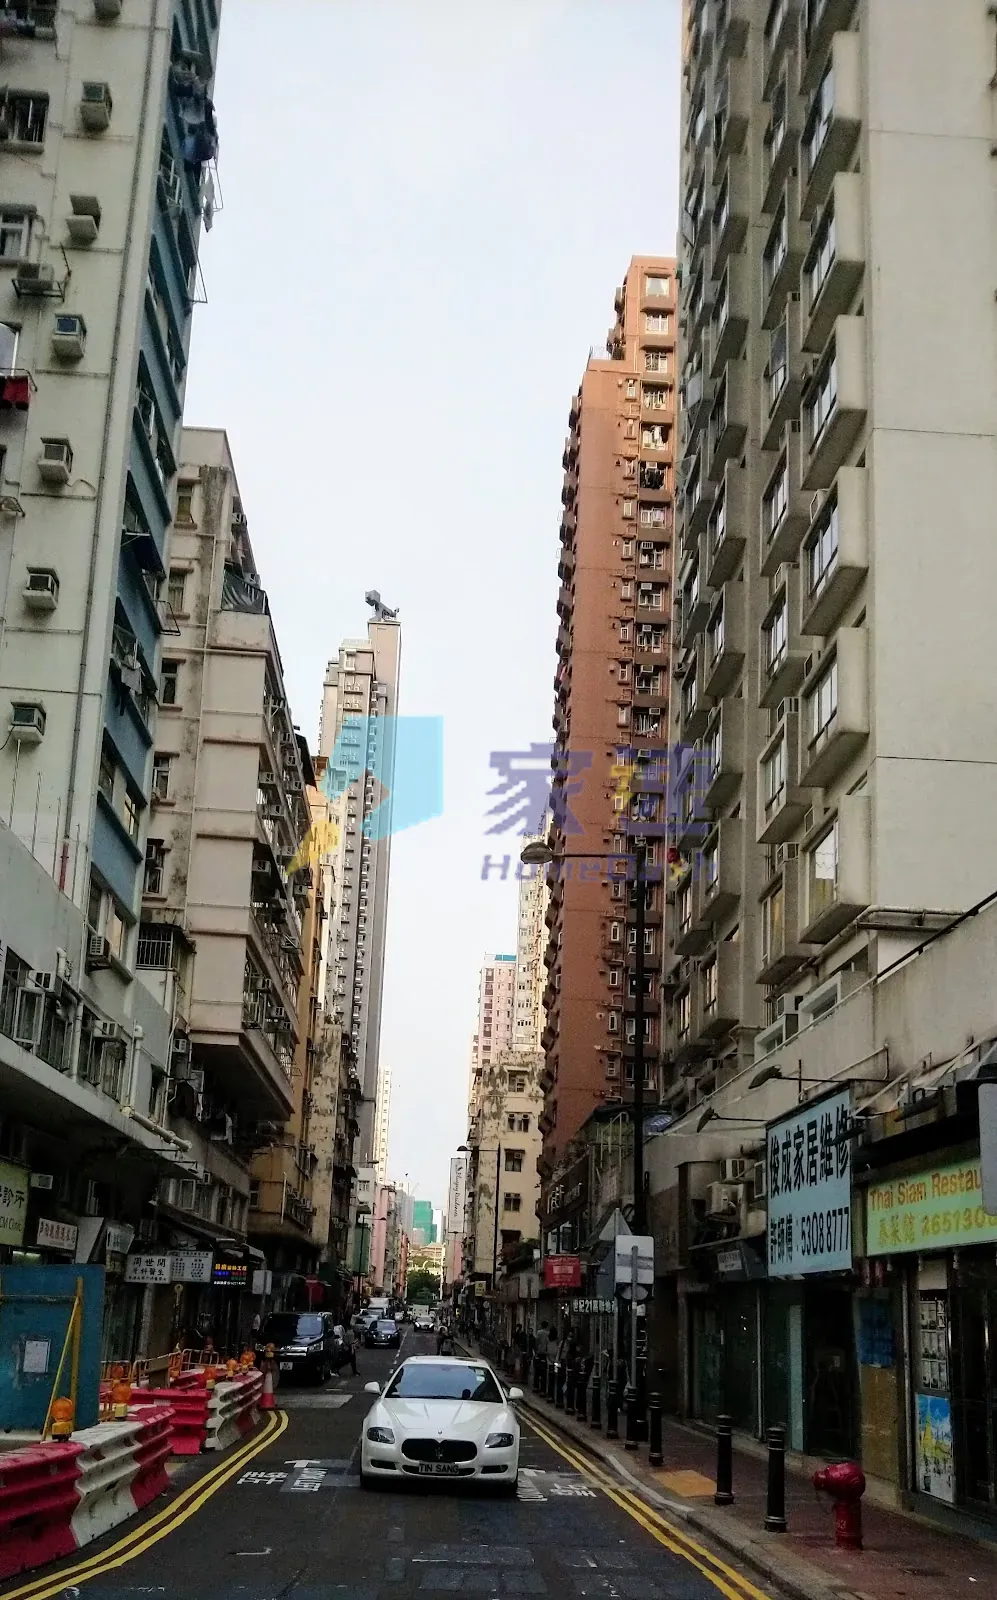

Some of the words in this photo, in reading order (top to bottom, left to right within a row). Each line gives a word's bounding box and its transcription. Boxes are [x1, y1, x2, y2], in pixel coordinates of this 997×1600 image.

[769, 1103, 851, 1199] 俊成家居維修
[869, 1184, 894, 1212] Thai
[897, 1179, 927, 1206] Siam
[419, 1464, 433, 1473] TIN
[436, 1464, 460, 1473] SANG
